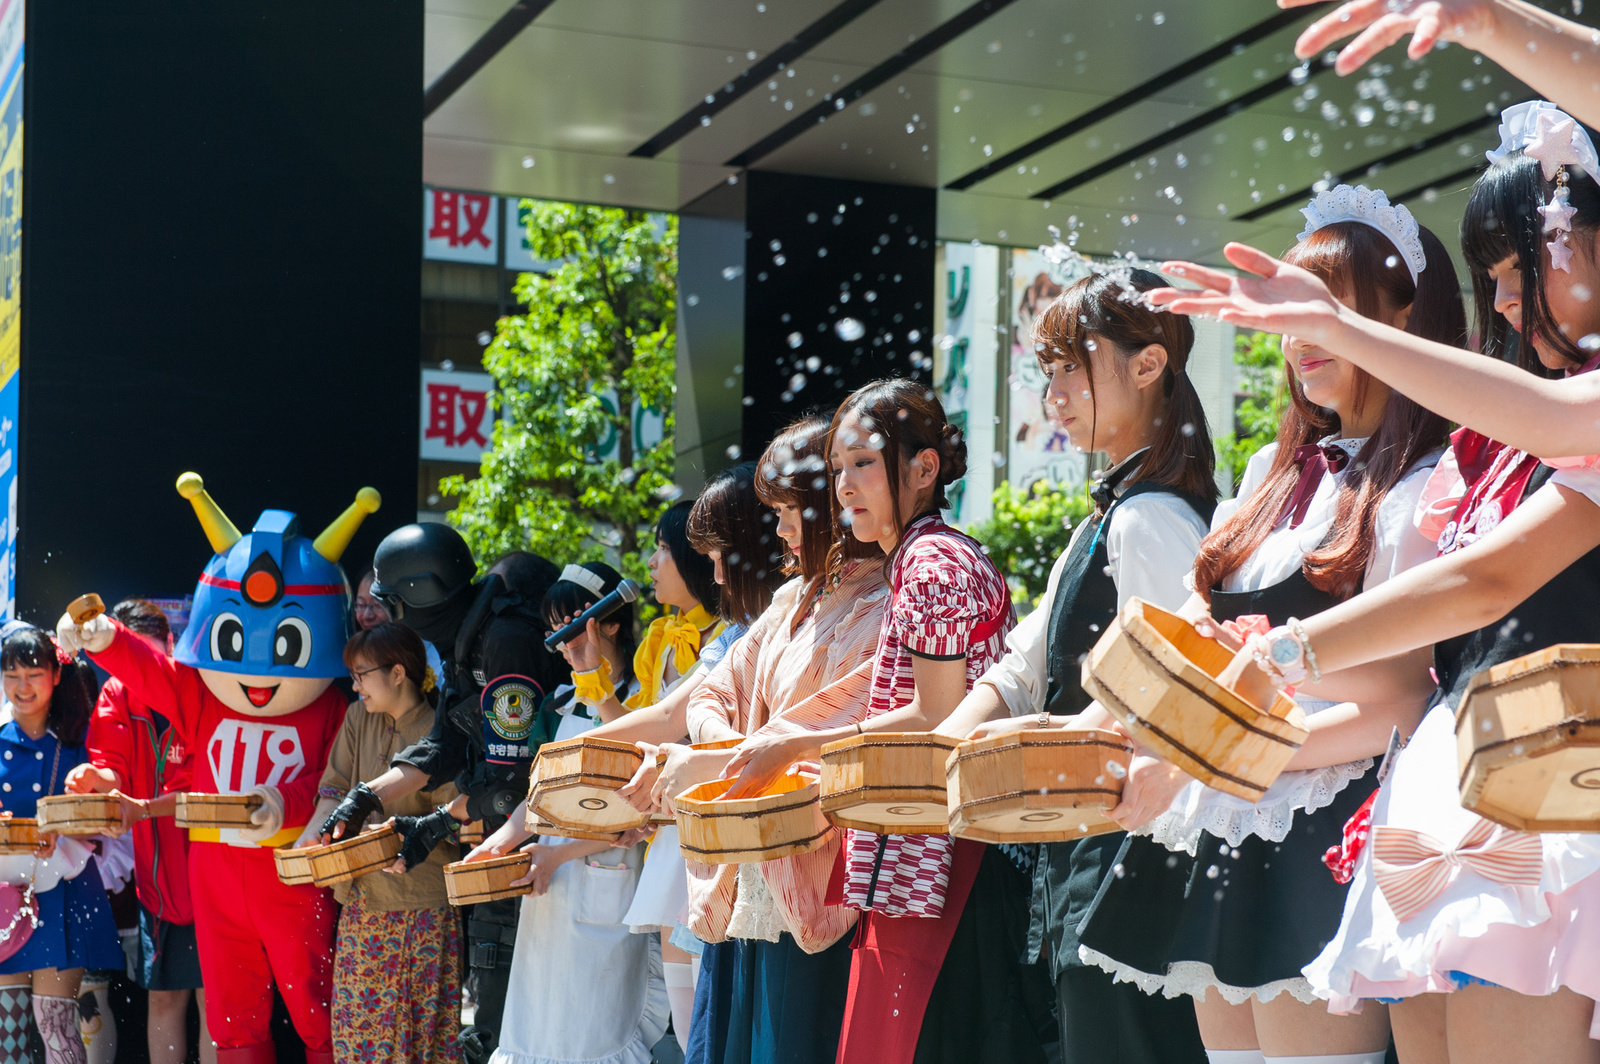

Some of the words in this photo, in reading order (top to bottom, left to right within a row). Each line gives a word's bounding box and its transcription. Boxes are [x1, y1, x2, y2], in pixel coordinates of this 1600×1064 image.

[429, 190, 492, 249] 取
[425, 383, 488, 448] 取
[488, 743, 532, 757] 自宅警備
